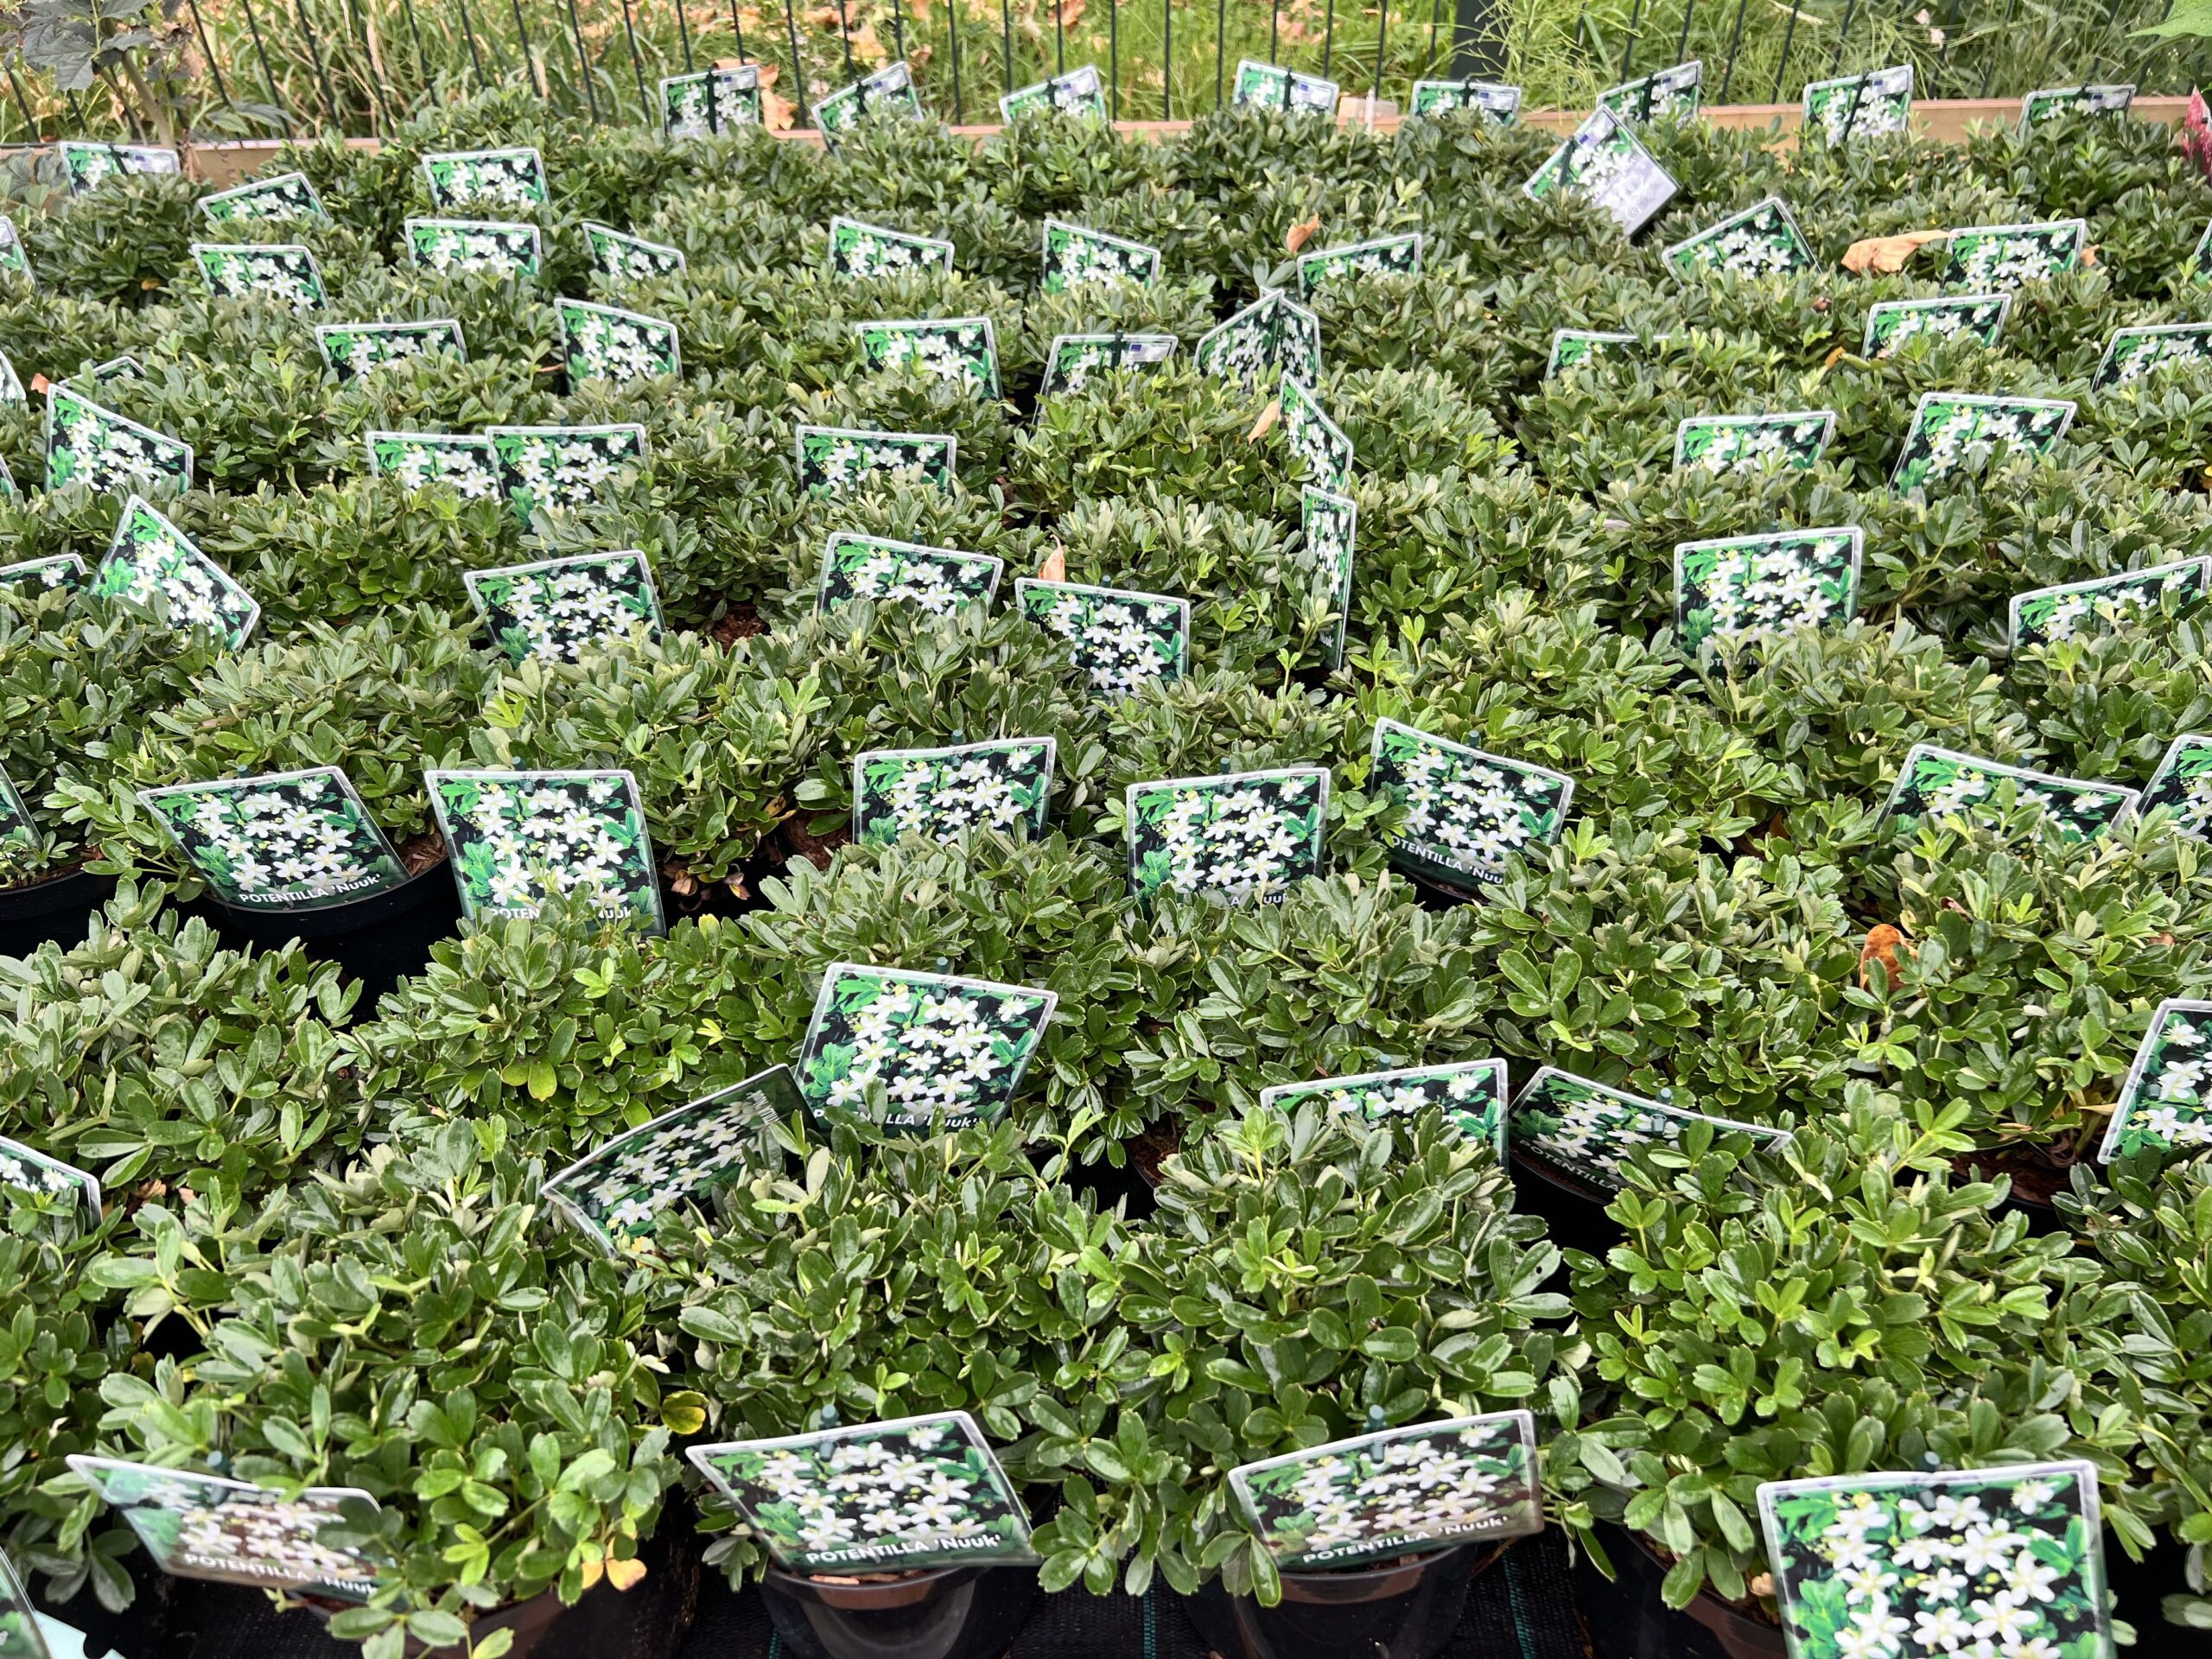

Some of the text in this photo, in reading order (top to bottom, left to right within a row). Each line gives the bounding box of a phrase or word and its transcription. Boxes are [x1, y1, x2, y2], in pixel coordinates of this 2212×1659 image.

[1381, 833, 1463, 872] OTENTILLA
[238, 874, 381, 904] POTENTILLA 'Nuuk'
[1519, 1140, 1619, 1192] POTENTILLA
[805, 1534, 1001, 1565] POTENTILLA 'Nuuk'
[1302, 1516, 1509, 1563] POTENTILLA 'Nuuk'
[183, 1553, 312, 1582] POTENTILLA
